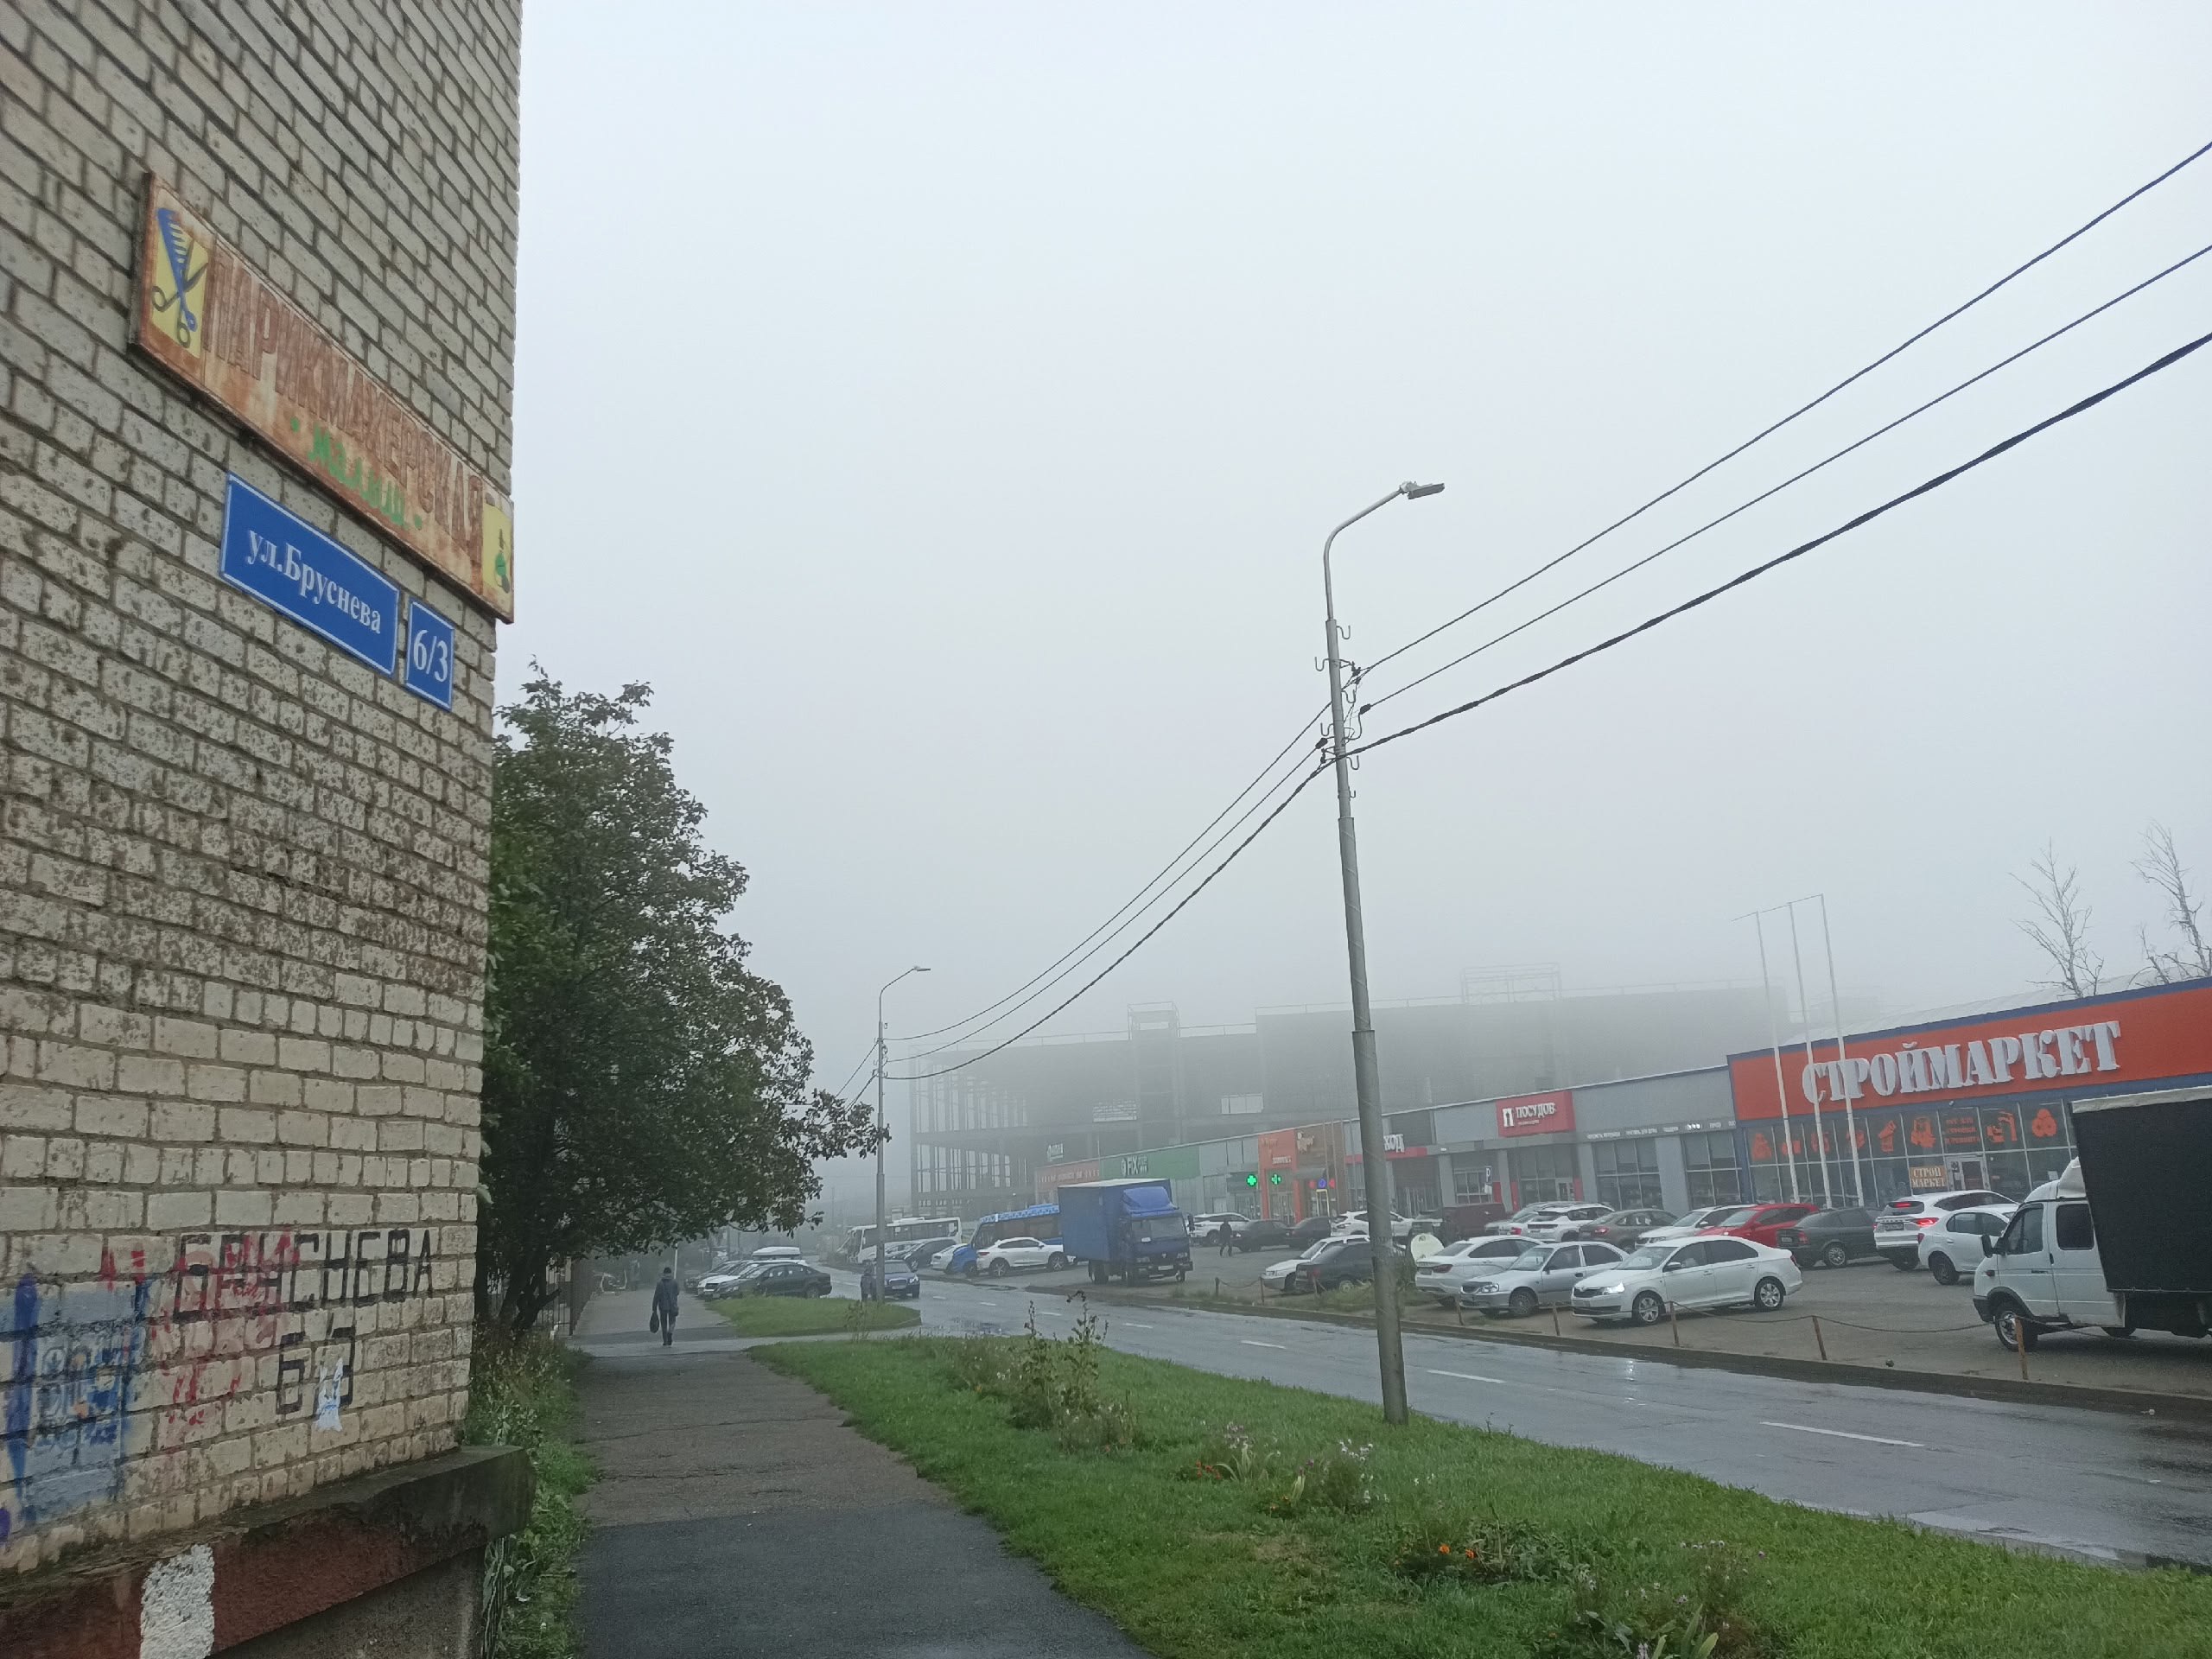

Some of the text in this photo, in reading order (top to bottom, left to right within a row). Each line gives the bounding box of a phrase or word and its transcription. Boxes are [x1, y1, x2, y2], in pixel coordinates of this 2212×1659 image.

[247, 530, 381, 634] ул.Бруснева
[413, 629, 448, 683] 6/3
[1802, 1020, 2121, 1104] СТРОЙМАРКЕТ
